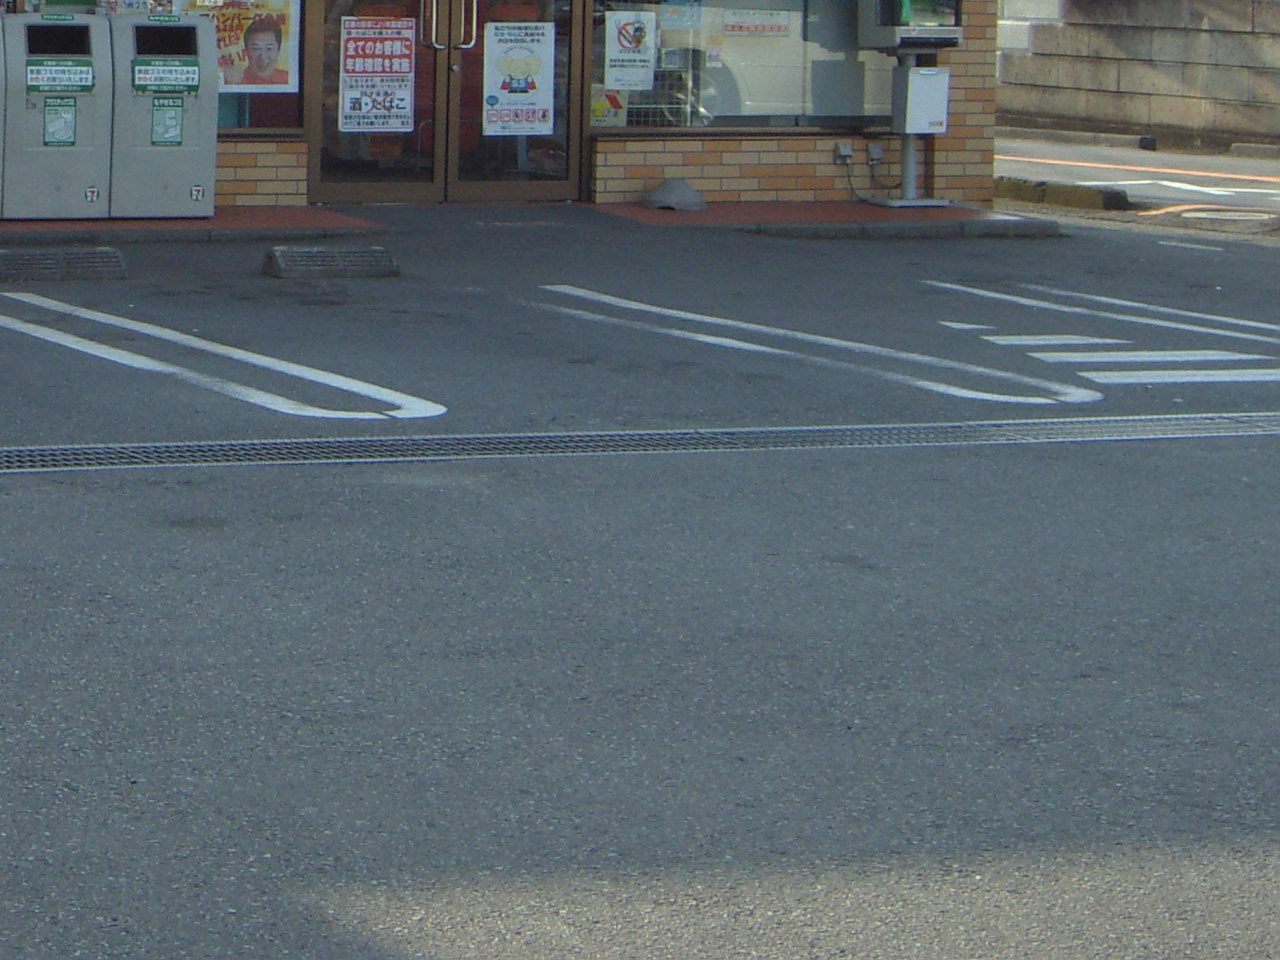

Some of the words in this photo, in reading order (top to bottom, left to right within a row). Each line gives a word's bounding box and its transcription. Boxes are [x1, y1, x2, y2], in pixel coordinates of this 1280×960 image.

[346, 40, 410, 56] 全てのお客様に
[346, 58, 410, 72] 年齢確認を実施
